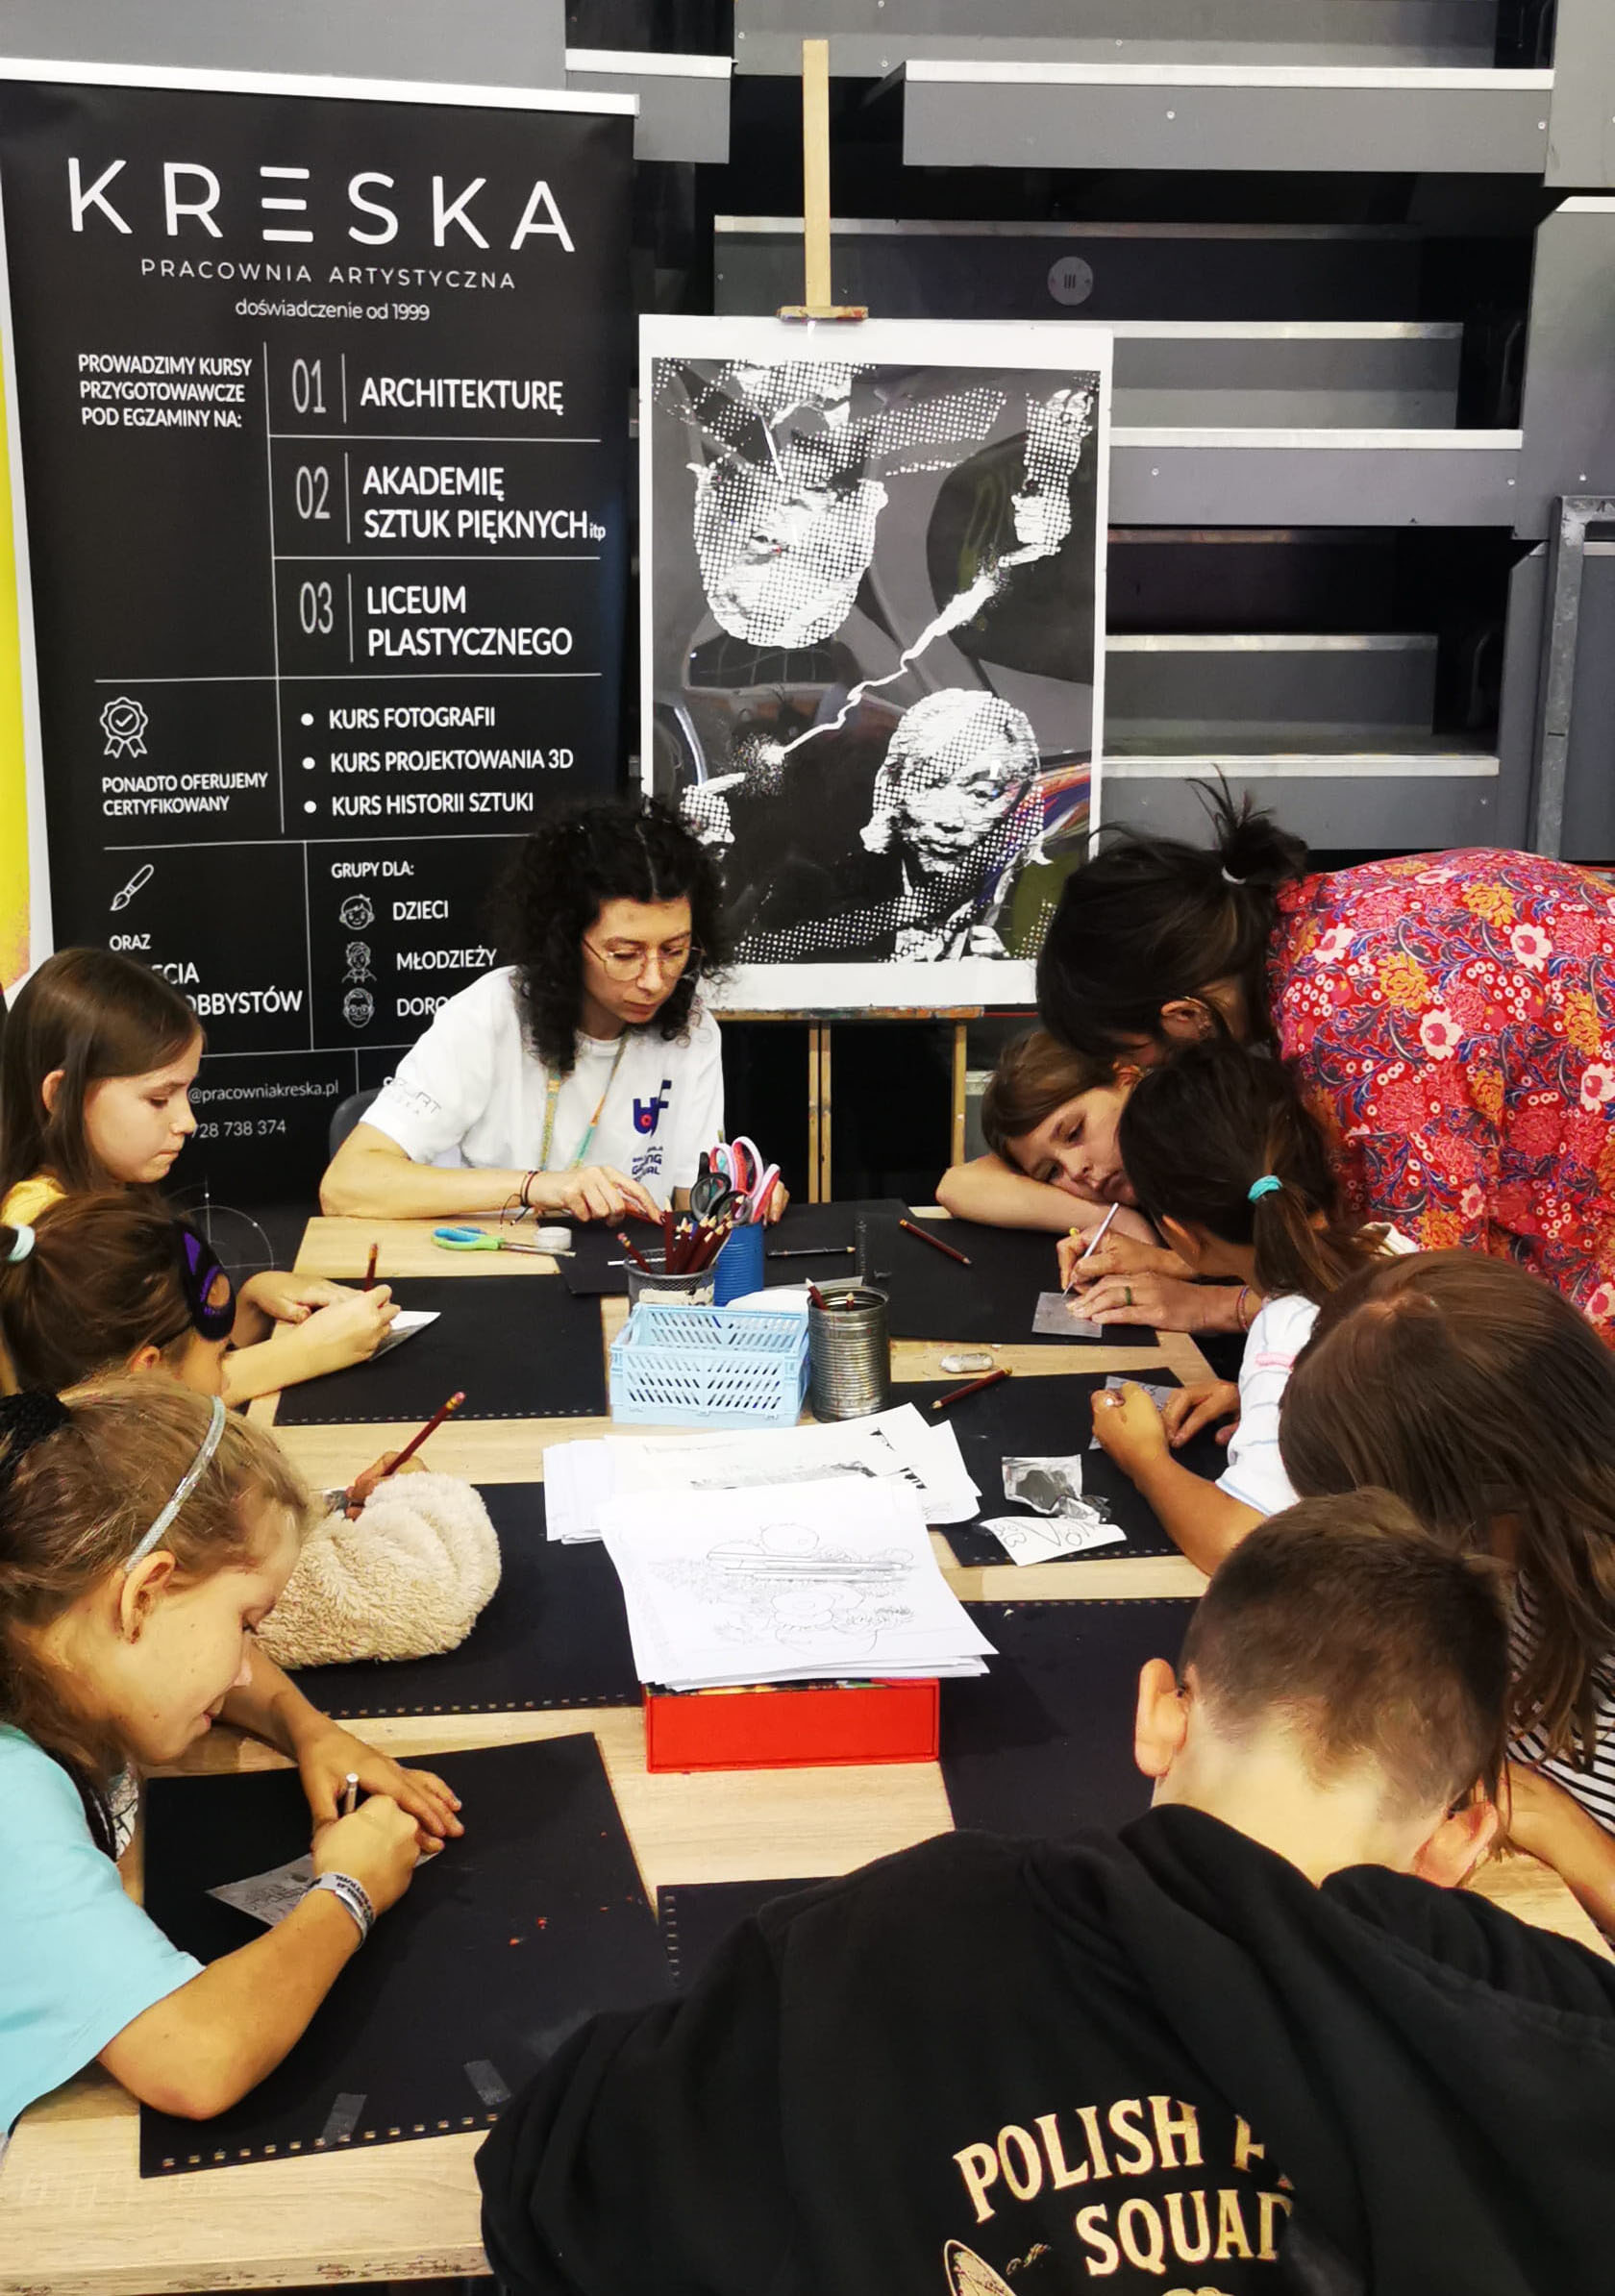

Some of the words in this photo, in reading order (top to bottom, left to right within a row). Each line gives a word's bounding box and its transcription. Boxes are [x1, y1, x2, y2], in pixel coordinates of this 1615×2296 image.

[68, 158, 575, 252] KRESKA
[141, 259, 311, 282] PRACOWNIA
[330, 266, 514, 288] ARTYSTYCZNA
[236, 299, 362, 318] doświadczenie
[366, 304, 388, 319] od
[392, 304, 430, 321] 1999
[79, 354, 195, 375] PROWADZIMY
[199, 358, 252, 376] KURSY
[80, 381, 245, 402] PRZYGOTOWAWCZE
[292, 358, 326, 413] 01
[360, 378, 563, 415] ARCHITEKTURĘ
[82, 407, 119, 426] POD
[123, 407, 211, 427] EGZAMINY
[214, 410, 241, 428] NA:
[296, 466, 331, 519] 02
[362, 466, 505, 502] AKADEMIĘ
[364, 509, 451, 538] SZTUK
[458, 509, 587, 544] PIĘKNYCH
[300, 581, 333, 633] 03
[367, 586, 465, 614] LICEUM
[368, 628, 572, 656] PLASTYCZNEGO
[330, 708, 379, 728] KURS
[385, 706, 495, 728] FOTOGRAFII
[331, 752, 381, 773] KURS
[385, 750, 545, 771] PROJEKTOWANIA
[549, 749, 573, 768] 3D
[102, 776, 177, 793] PONADTO
[181, 773, 268, 790] OFERUJEMY
[103, 796, 229, 815] CERTYFIKOWANY
[333, 795, 382, 816] KURS
[386, 793, 463, 814] HISTORII
[469, 793, 533, 812] SZTUKI
[332, 862, 380, 878] GRUPY
[383, 861, 413, 876] DLA:
[393, 901, 448, 920] DZIECI
[110, 934, 151, 950] ORAZ
[397, 946, 497, 971] MŁODZIEŻY
[224, 1122, 252, 1135] 738
[259, 1120, 286, 1134] 374
[953, 2096, 1204, 2224] POLISH
